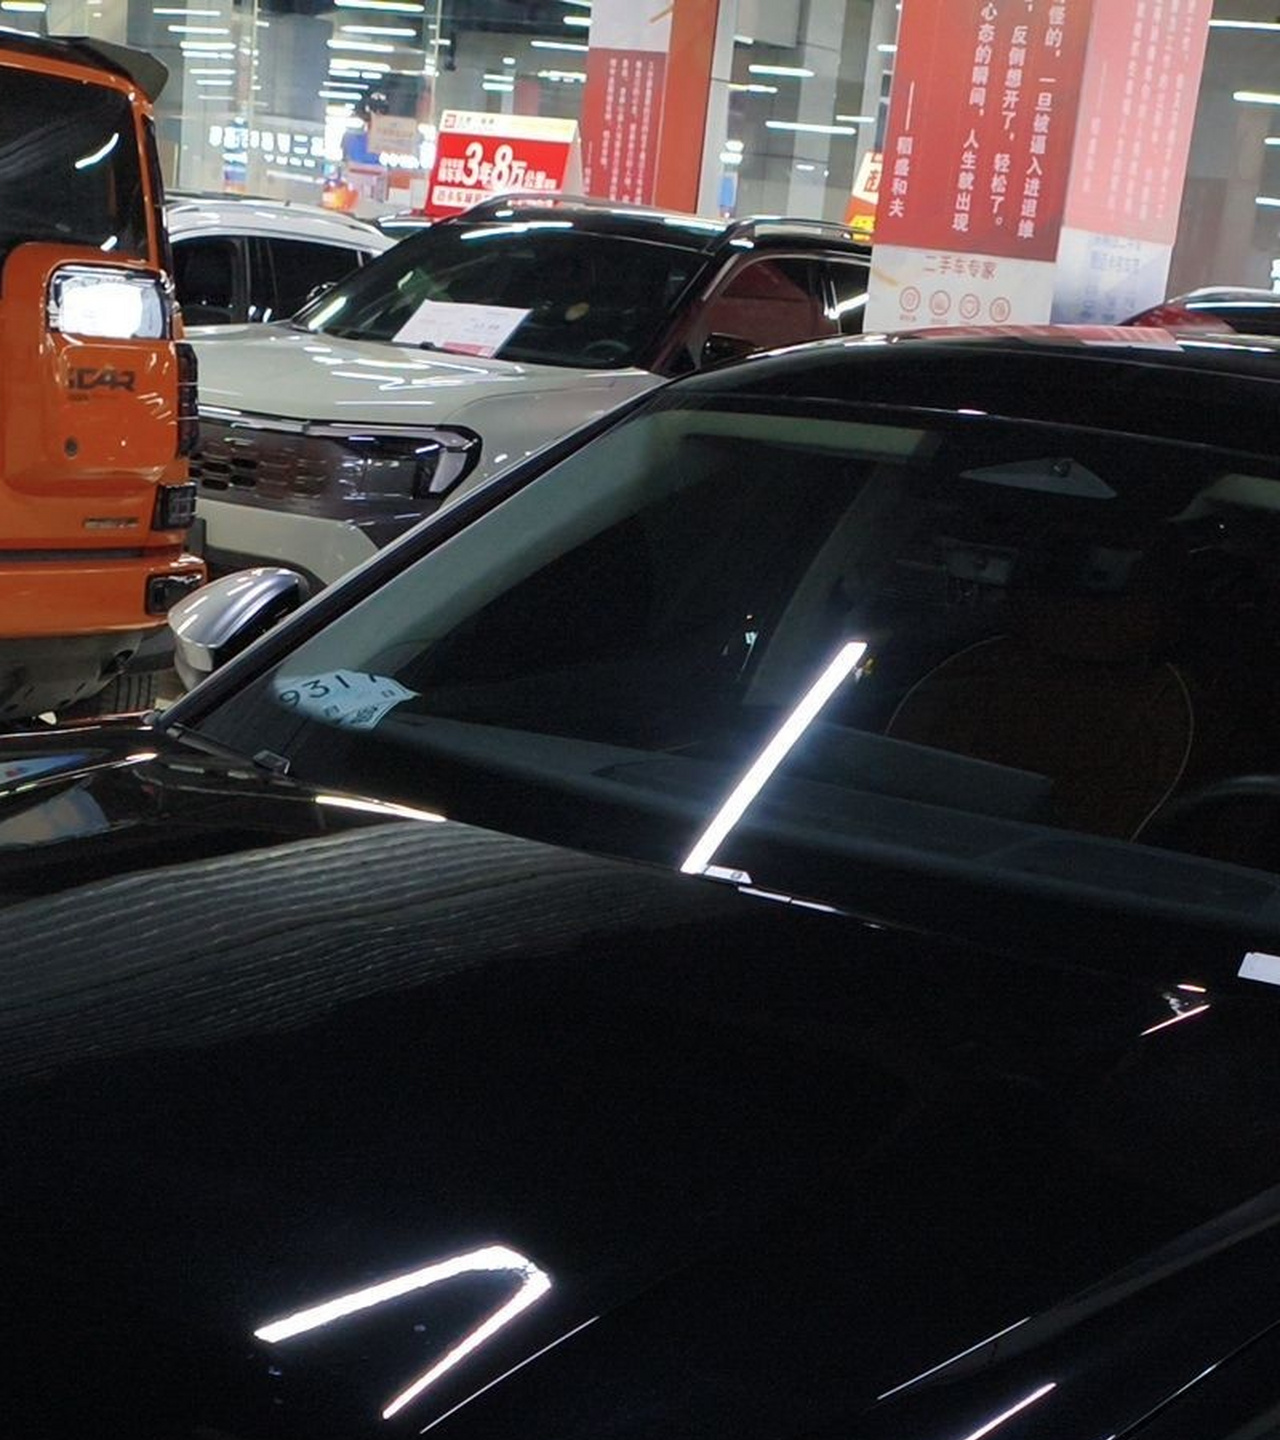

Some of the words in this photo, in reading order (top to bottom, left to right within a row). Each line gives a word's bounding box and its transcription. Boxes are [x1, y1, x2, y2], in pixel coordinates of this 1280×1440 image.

[989, 0, 1033, 226] ，反倒想开了，轻松了。
[1017, 0, 1066, 239] 怪的，一旦被逼入进退维
[923, 255, 997, 280] 二手车专家
